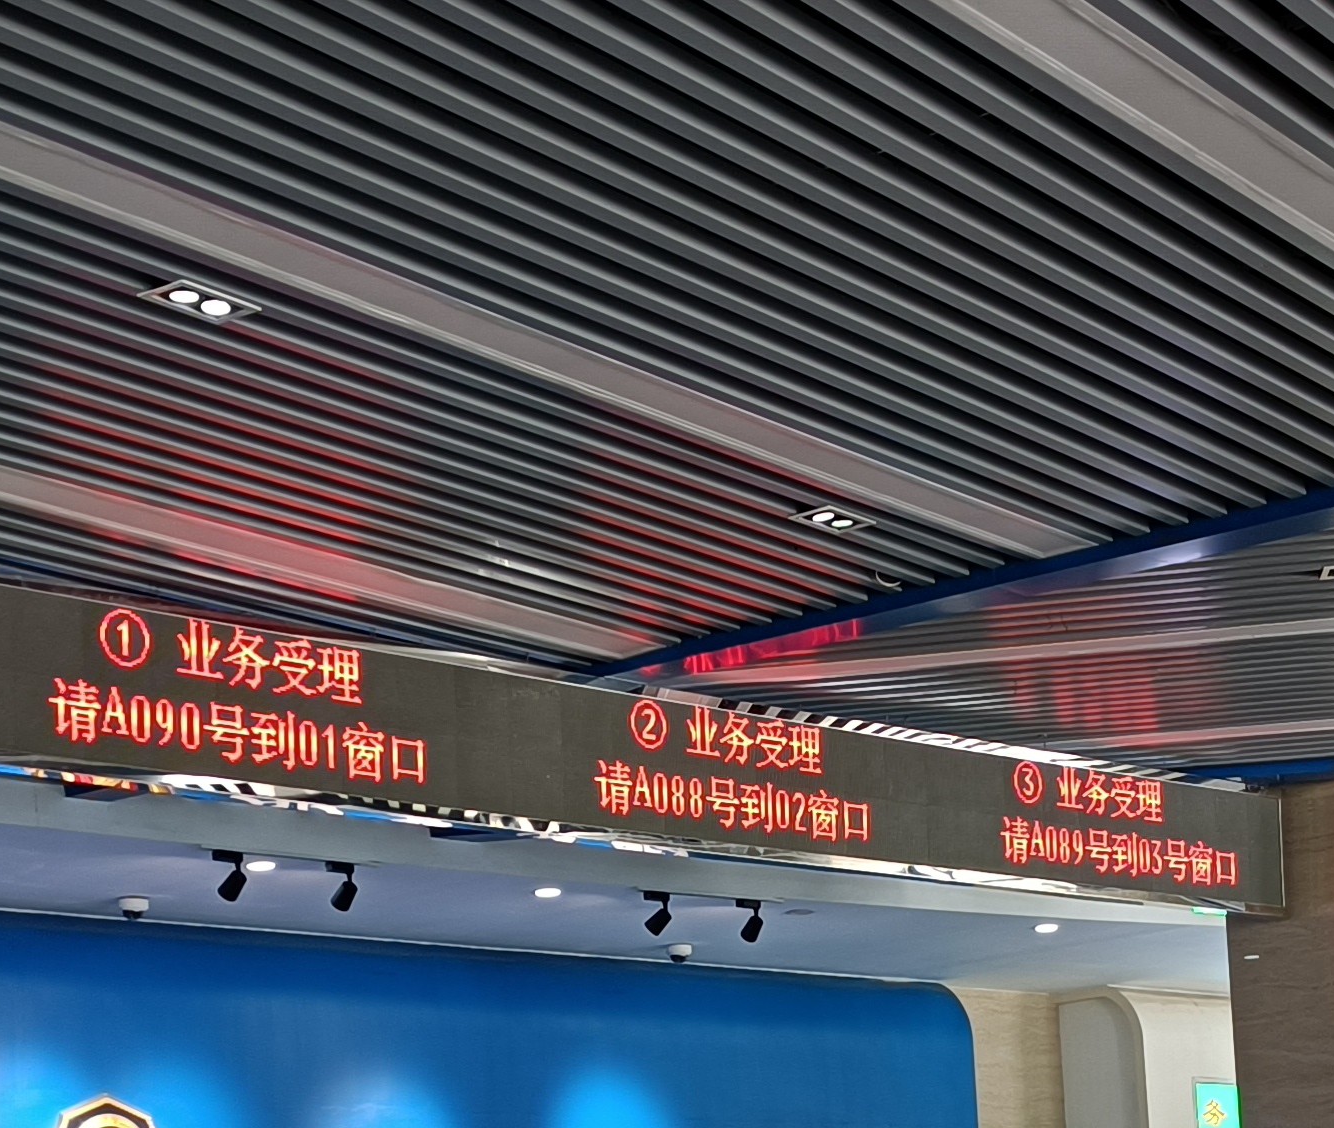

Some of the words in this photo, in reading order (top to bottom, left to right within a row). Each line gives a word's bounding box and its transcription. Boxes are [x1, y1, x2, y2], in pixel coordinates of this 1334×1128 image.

[176, 618, 363, 705] 业务受理
[49, 677, 426, 784] 请A090号到01窗口
[685, 706, 823, 774] 业务受理
[595, 759, 870, 842] 请A088号到02窗口
[1056, 768, 1163, 823] 业务受理
[1000, 817, 1237, 887] 请A089号到03号窗口
[1202, 1099, 1227, 1127] 务
